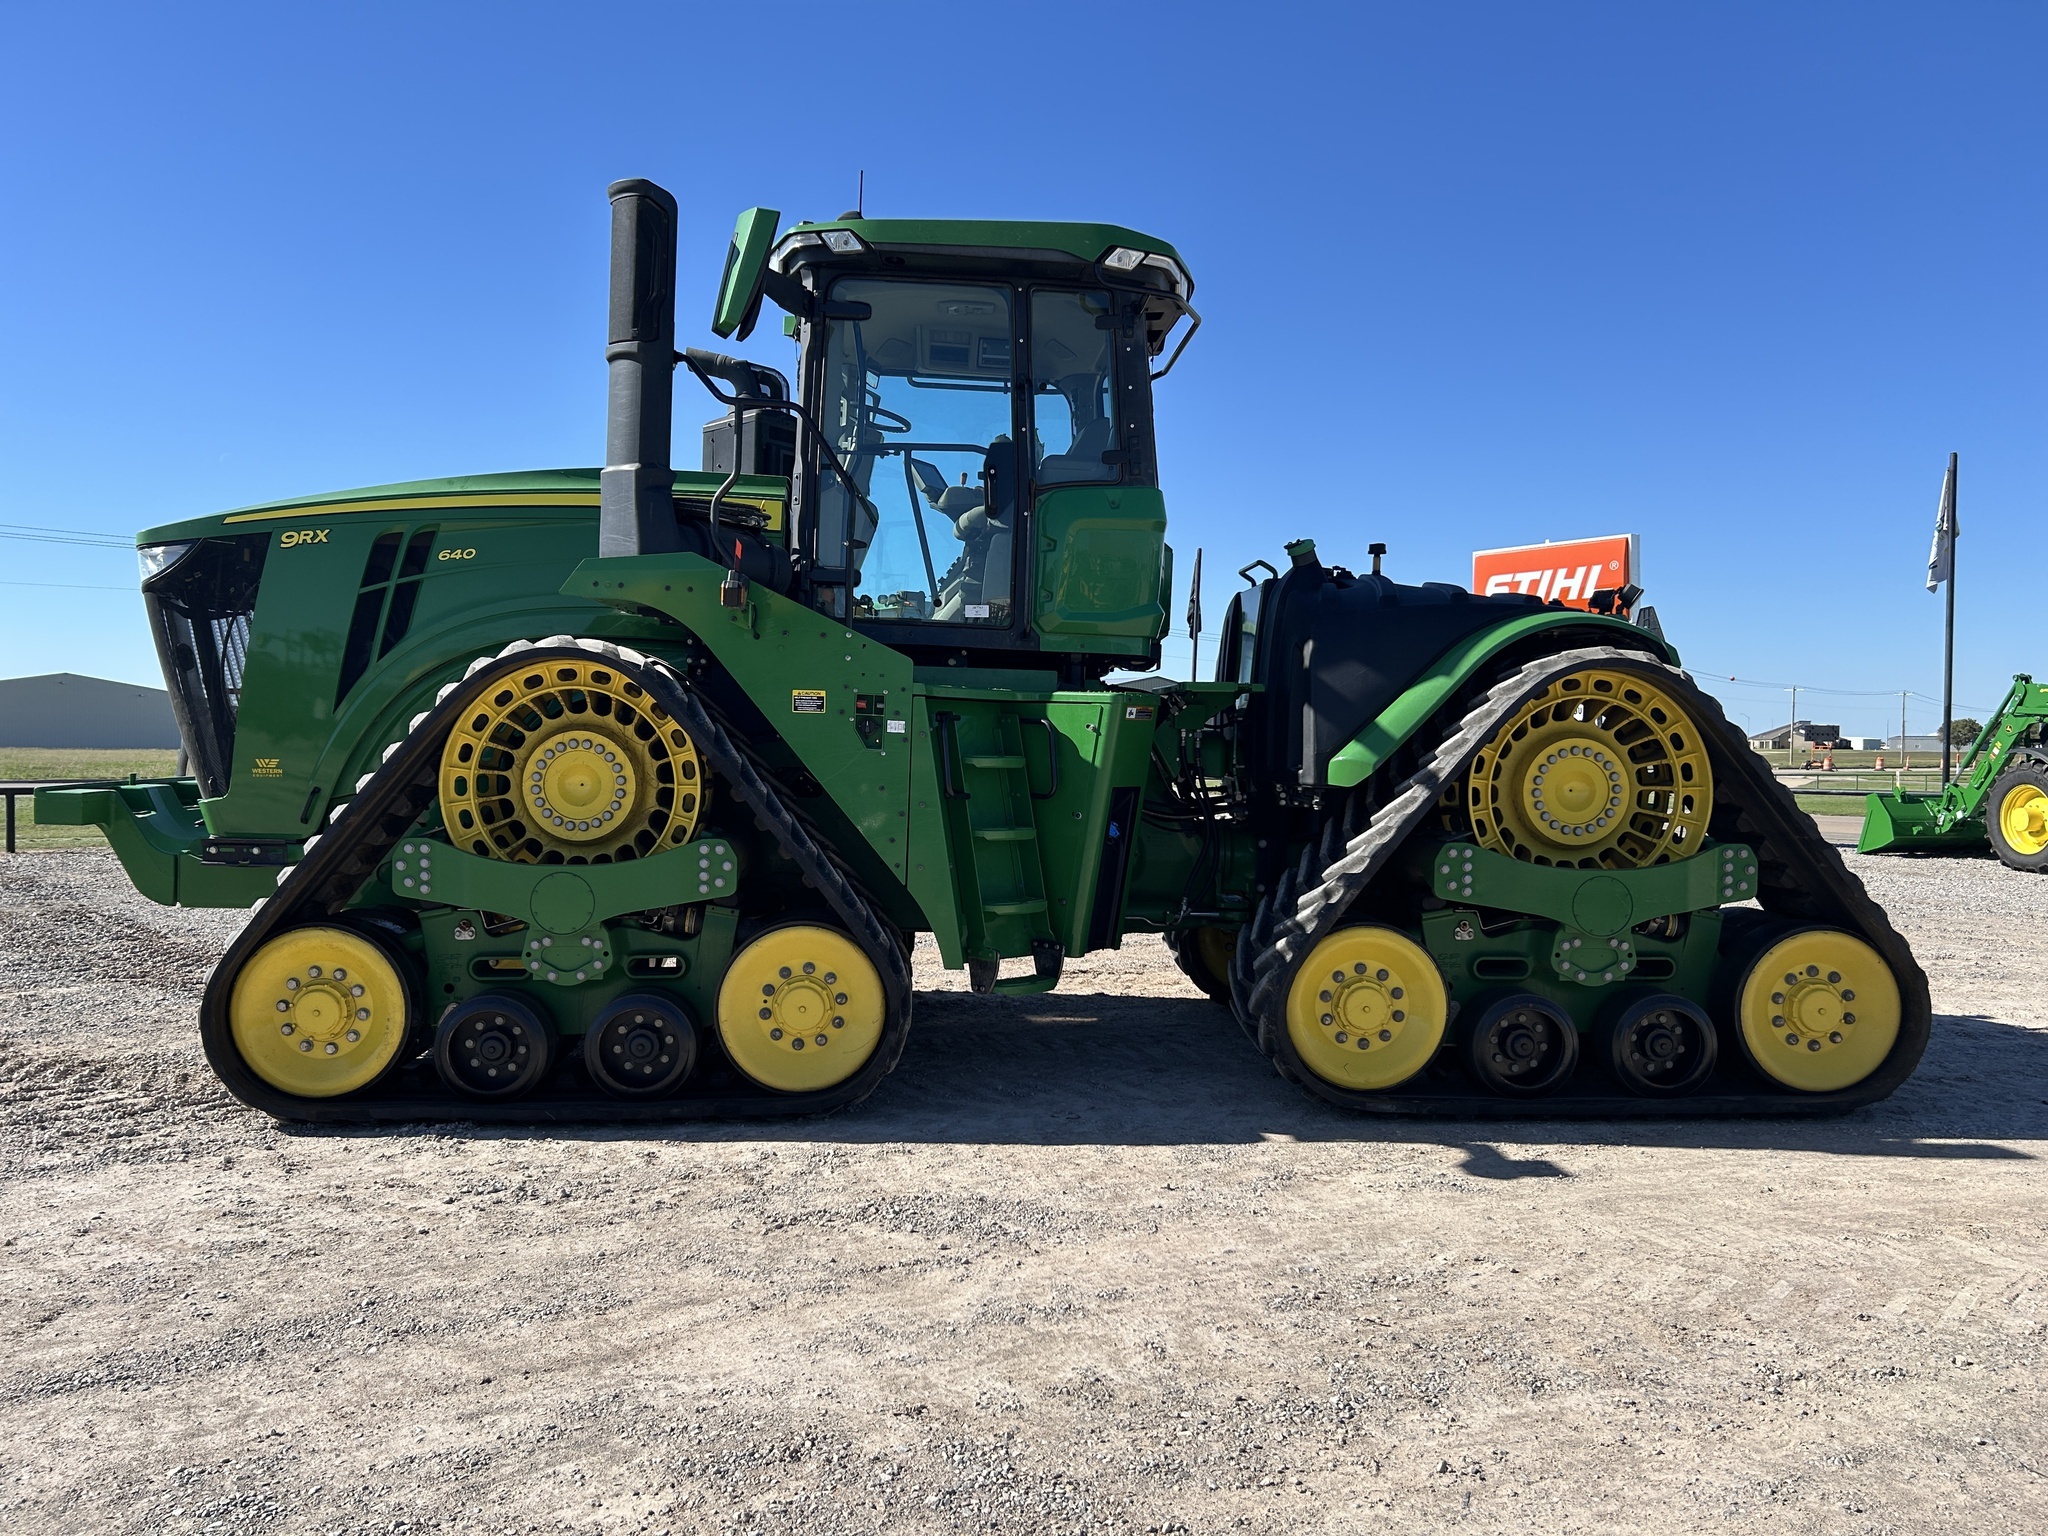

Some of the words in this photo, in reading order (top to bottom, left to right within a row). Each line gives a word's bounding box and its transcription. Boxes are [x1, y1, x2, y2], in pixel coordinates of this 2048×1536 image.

[280, 529, 331, 548] 9RX
[438, 548, 477, 561] 640
[1485, 564, 1613, 602] STIHL
